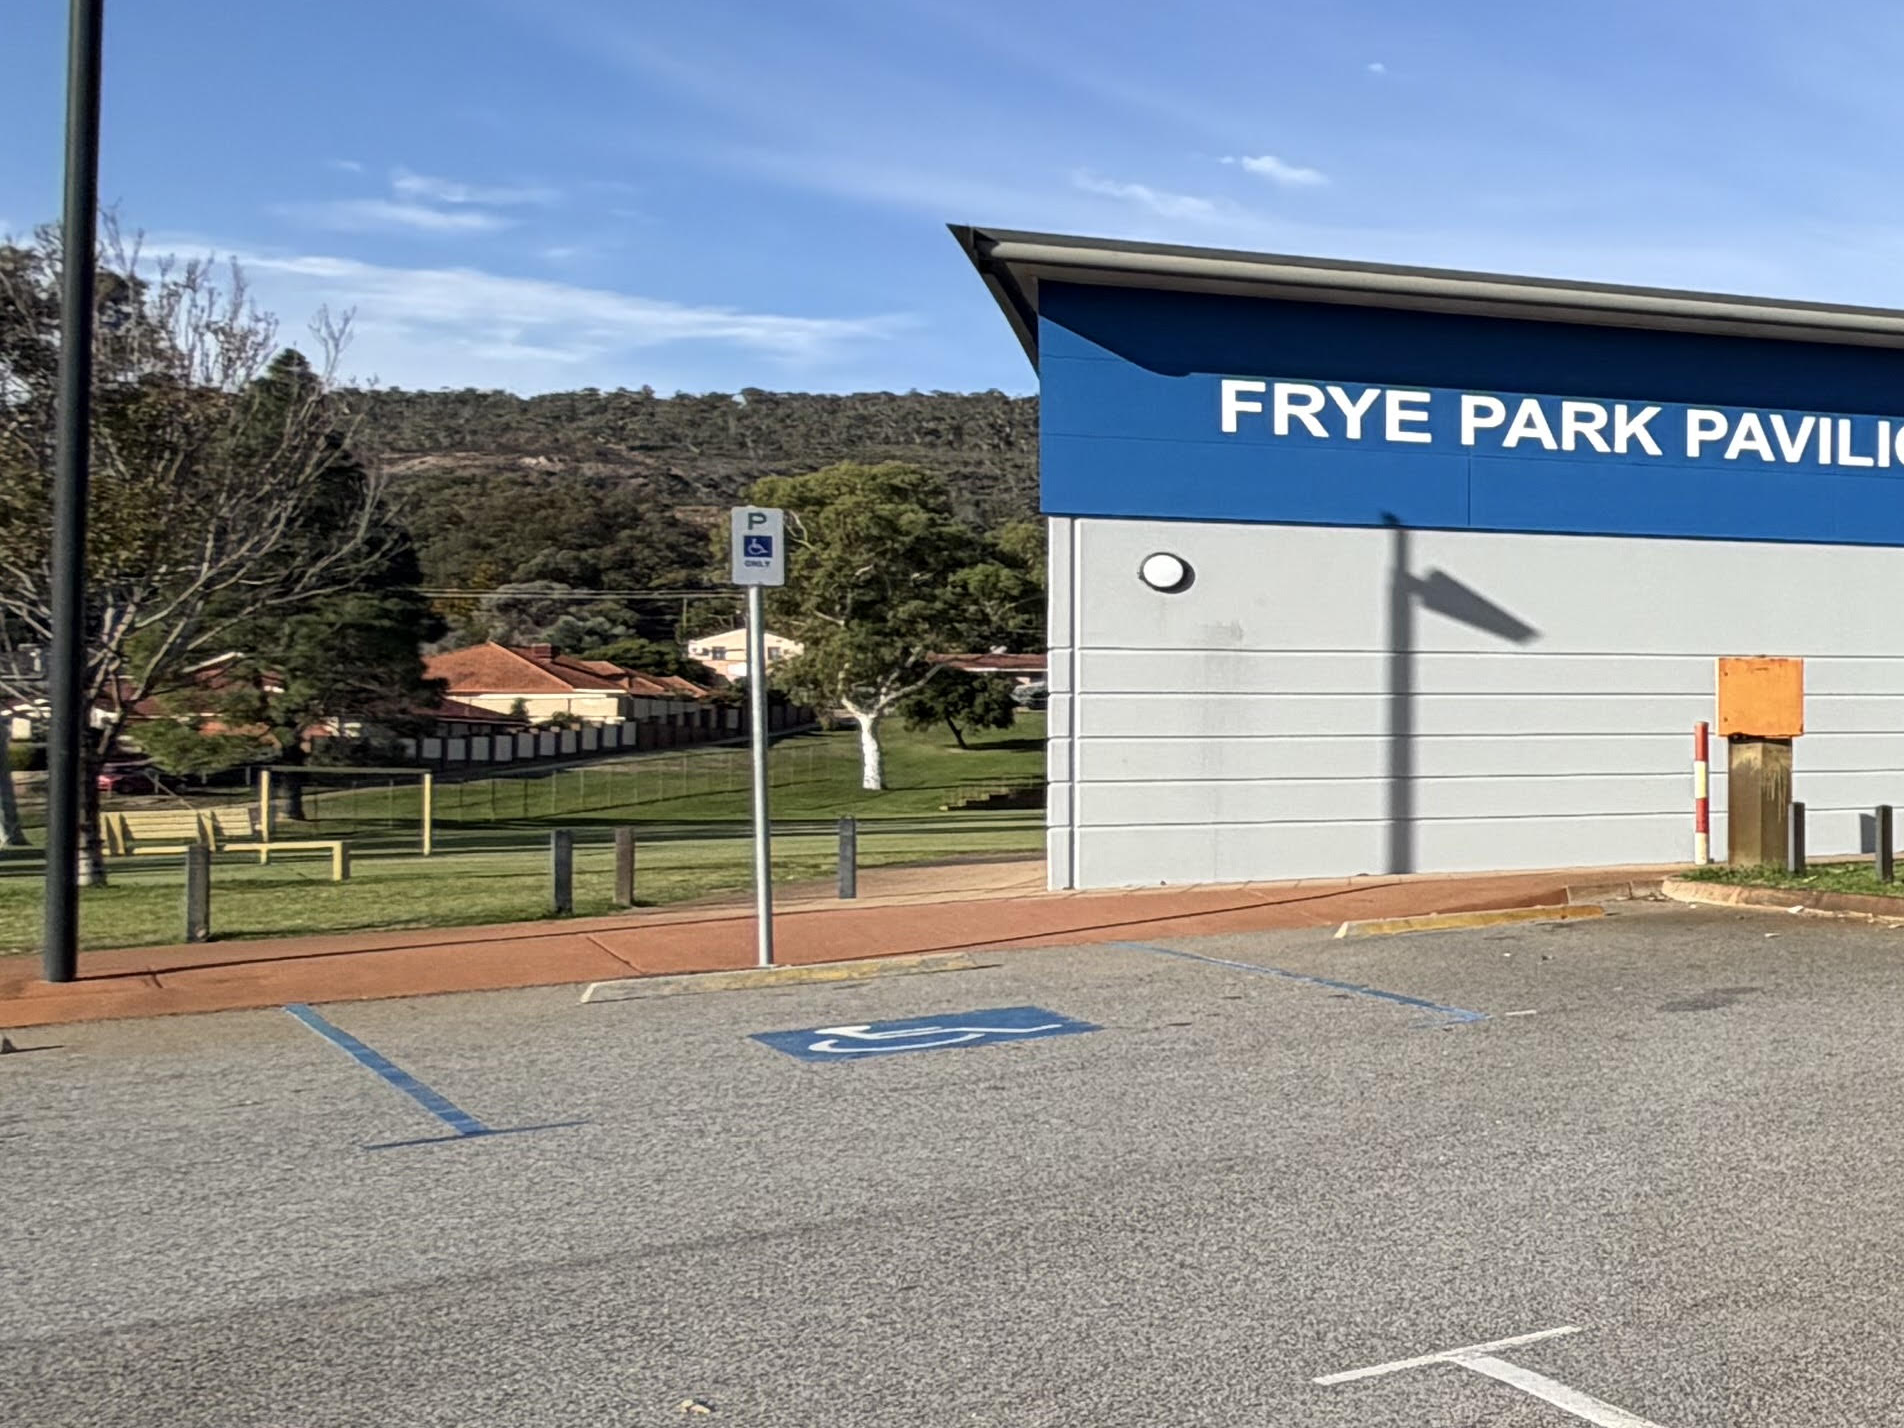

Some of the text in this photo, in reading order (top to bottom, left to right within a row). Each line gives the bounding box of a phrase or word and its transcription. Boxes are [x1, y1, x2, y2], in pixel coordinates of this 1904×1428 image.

[1220, 379, 1432, 443] FRYE
[1461, 394, 1663, 456] PARK
[748, 512, 767, 530] P
